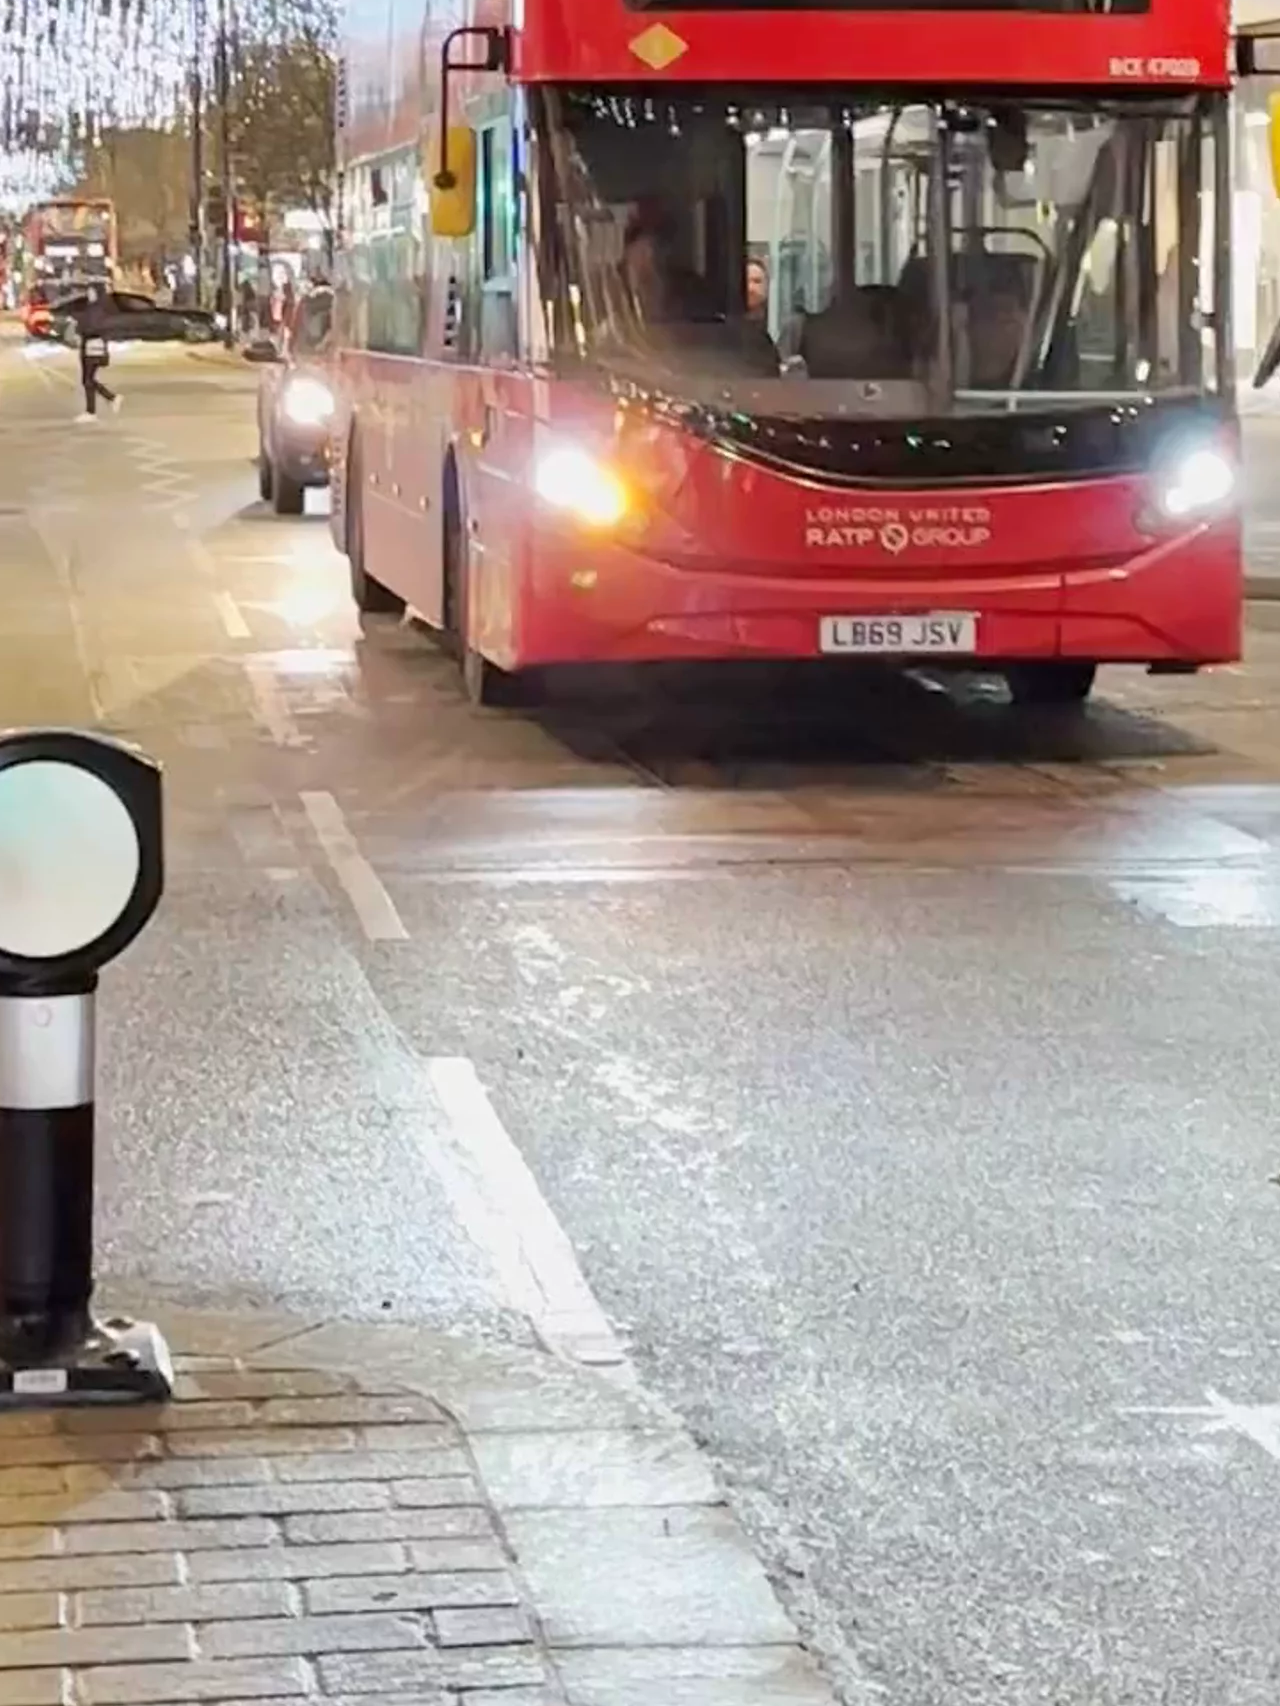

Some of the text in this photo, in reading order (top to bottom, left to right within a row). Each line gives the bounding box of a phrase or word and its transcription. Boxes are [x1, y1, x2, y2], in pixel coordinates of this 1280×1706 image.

[805, 506, 991, 523] LONDON UNITED
[805, 526, 991, 547] RATP GROUP
[832, 620, 964, 647] LB69 JSV
